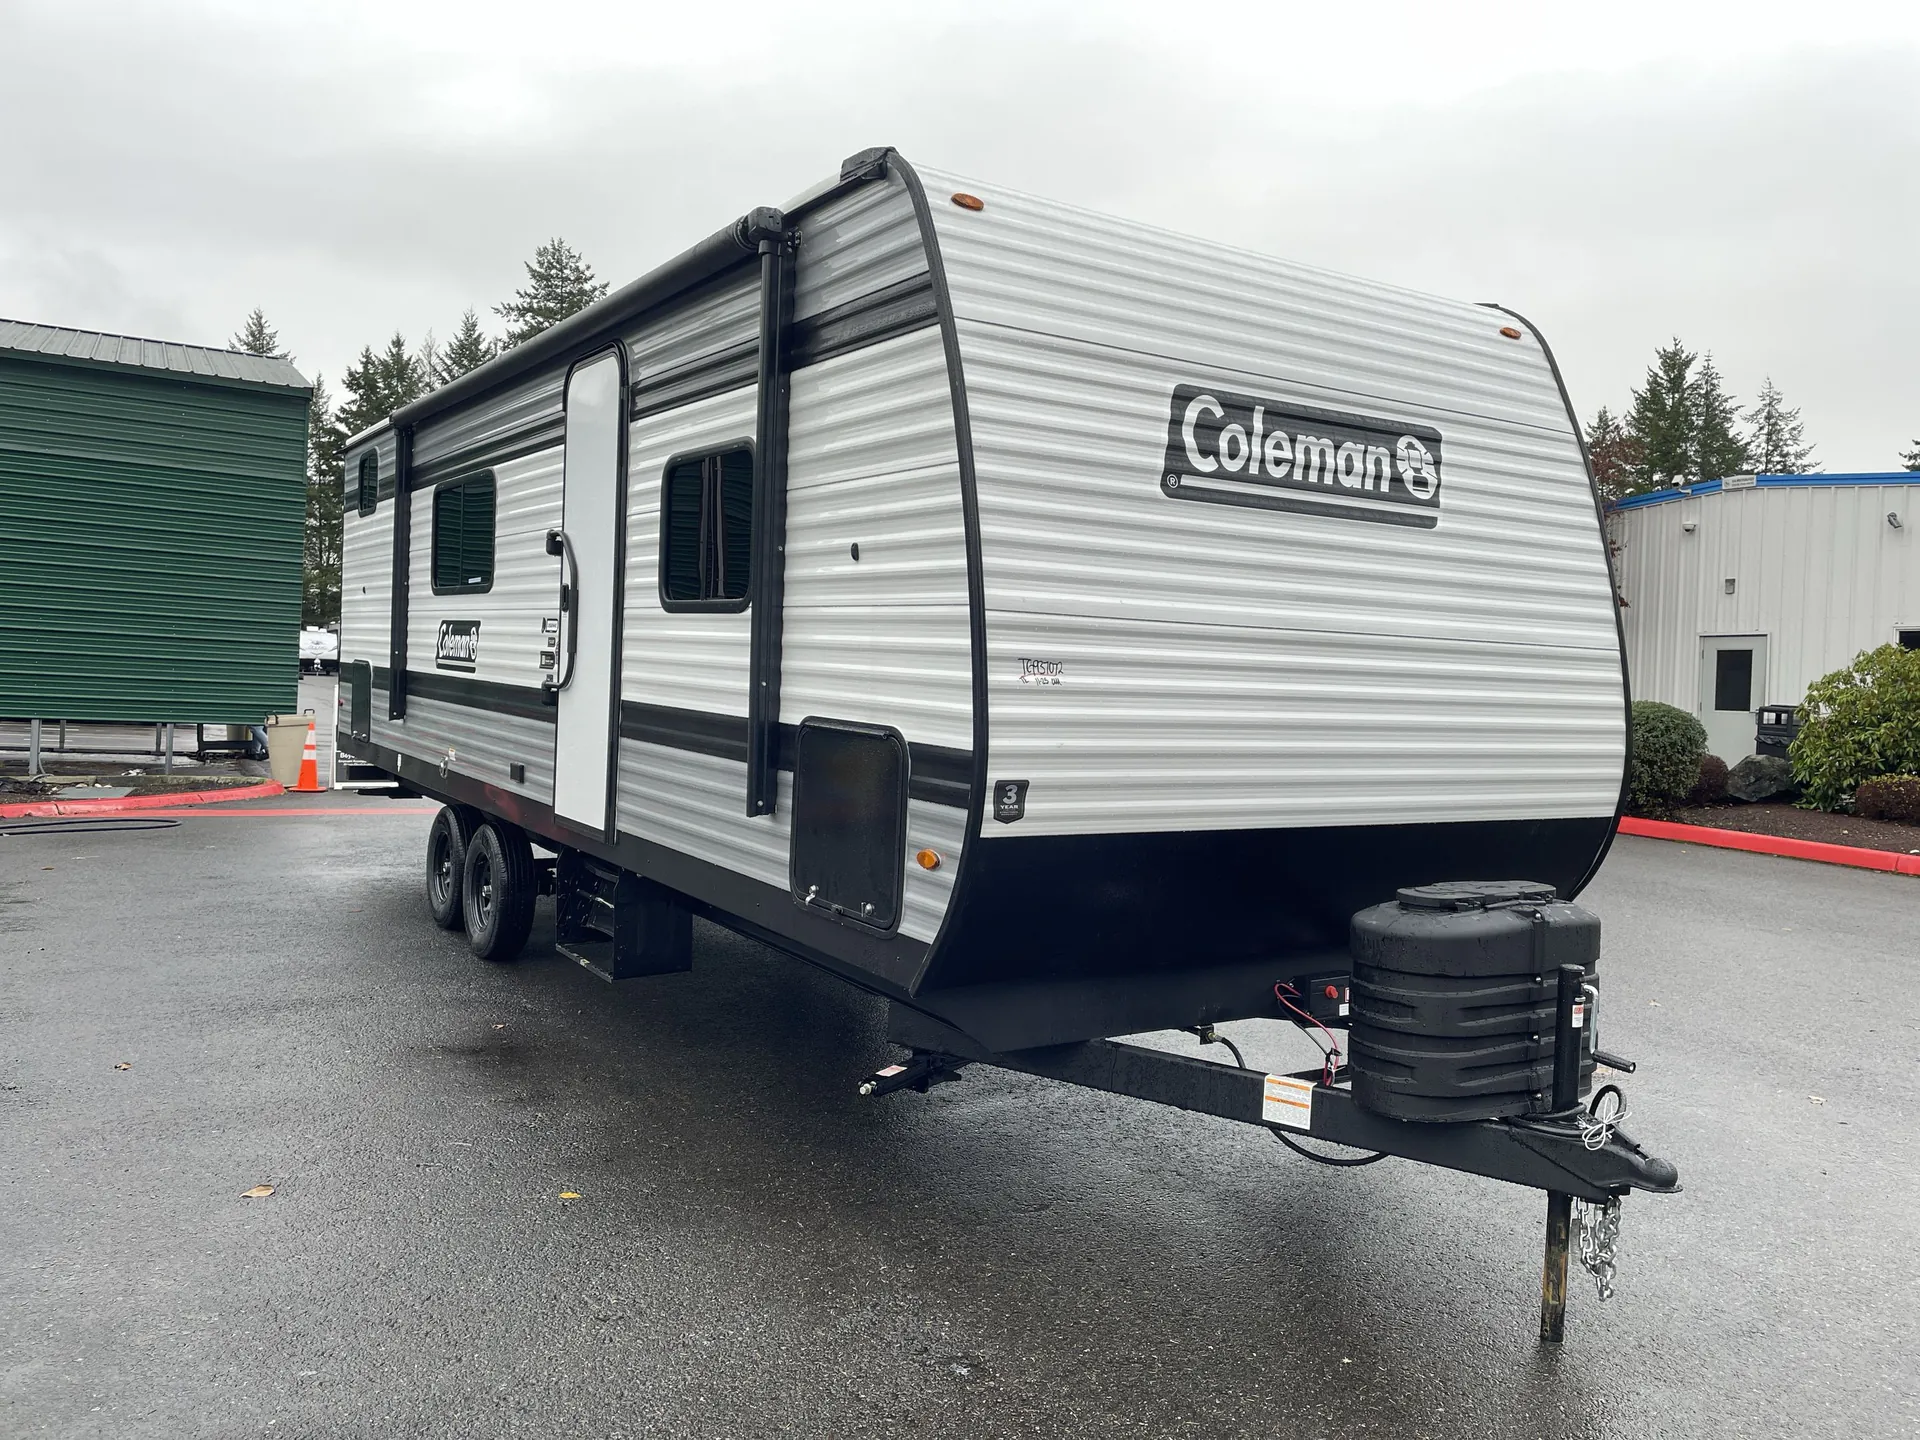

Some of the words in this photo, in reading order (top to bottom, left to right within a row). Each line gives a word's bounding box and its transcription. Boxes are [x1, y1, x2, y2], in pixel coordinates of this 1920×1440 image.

[1181, 394, 1391, 493] Coleman
[438, 623, 470, 658] Coleman
[1002, 784, 1018, 804] 3
